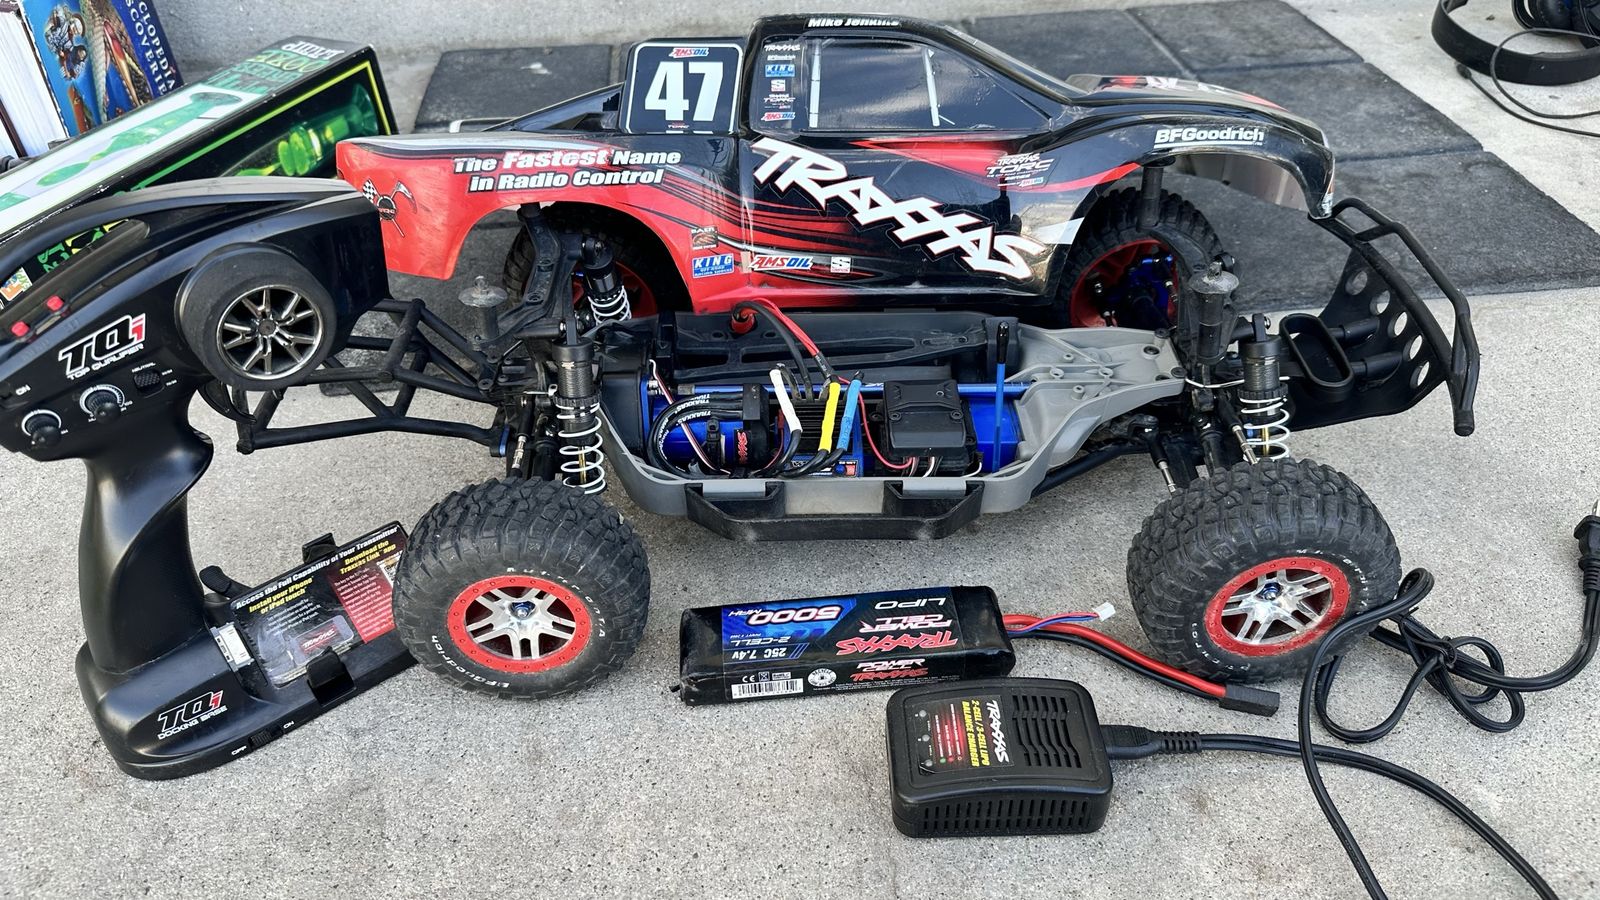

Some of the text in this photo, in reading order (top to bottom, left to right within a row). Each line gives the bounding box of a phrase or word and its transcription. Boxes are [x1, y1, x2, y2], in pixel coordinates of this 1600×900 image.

[808, 18, 843, 28] Mike
[138, 2, 175, 89] CLOPEDIA
[670, 48, 709, 58] AMSOIL
[645, 61, 724, 121] 47
[761, 112, 796, 121] AMSOIL
[1154, 127, 1265, 144] BFGoodrich
[454, 149, 682, 173] The Fastest Name
[986, 158, 1055, 175] TORC
[469, 168, 664, 192] in Radio Control
[752, 137, 1046, 279] TRAXXAS
[694, 254, 732, 269] KING
[751, 255, 813, 270] AMSOIL
[58, 313, 146, 376] TQi
[66, 342, 145, 381] TOP QUALIFIER
[15, 384, 32, 396] ON
[339, 558, 367, 575] Traxxas
[383, 543, 397, 554] app
[344, 545, 379, 566] Download
[378, 540, 390, 552] the
[235, 526, 398, 610] Access the Full Capability of Your Transmitter
[248, 597, 272, 613] Install
[271, 590, 289, 603] your
[260, 606, 269, 615] or
[285, 588, 306, 602] touch
[875, 597, 947, 610] LIPO
[746, 604, 842, 626] 5000
[859, 619, 953, 633] POWER
[876, 614, 944, 624] CELL
[730, 636, 791, 647] 2-CELL
[835, 630, 959, 656] TRAXXAS
[731, 647, 788, 660] 25C 7.4v
[856, 658, 926, 669] POWER
[850, 668, 928, 682] TRAXXAS
[157, 690, 224, 733] TQi
[971, 699, 983, 722] 2-CELL
[157, 704, 228, 740] DOCKING BASE
[283, 720, 295, 729] ON
[986, 699, 1010, 763] TRAXXAS
[961, 701, 980, 767] BALANCE CHARGER
[976, 726, 988, 749] 3-CELL
[231, 745, 247, 756] OFF
[980, 748, 990, 766] LIPO
